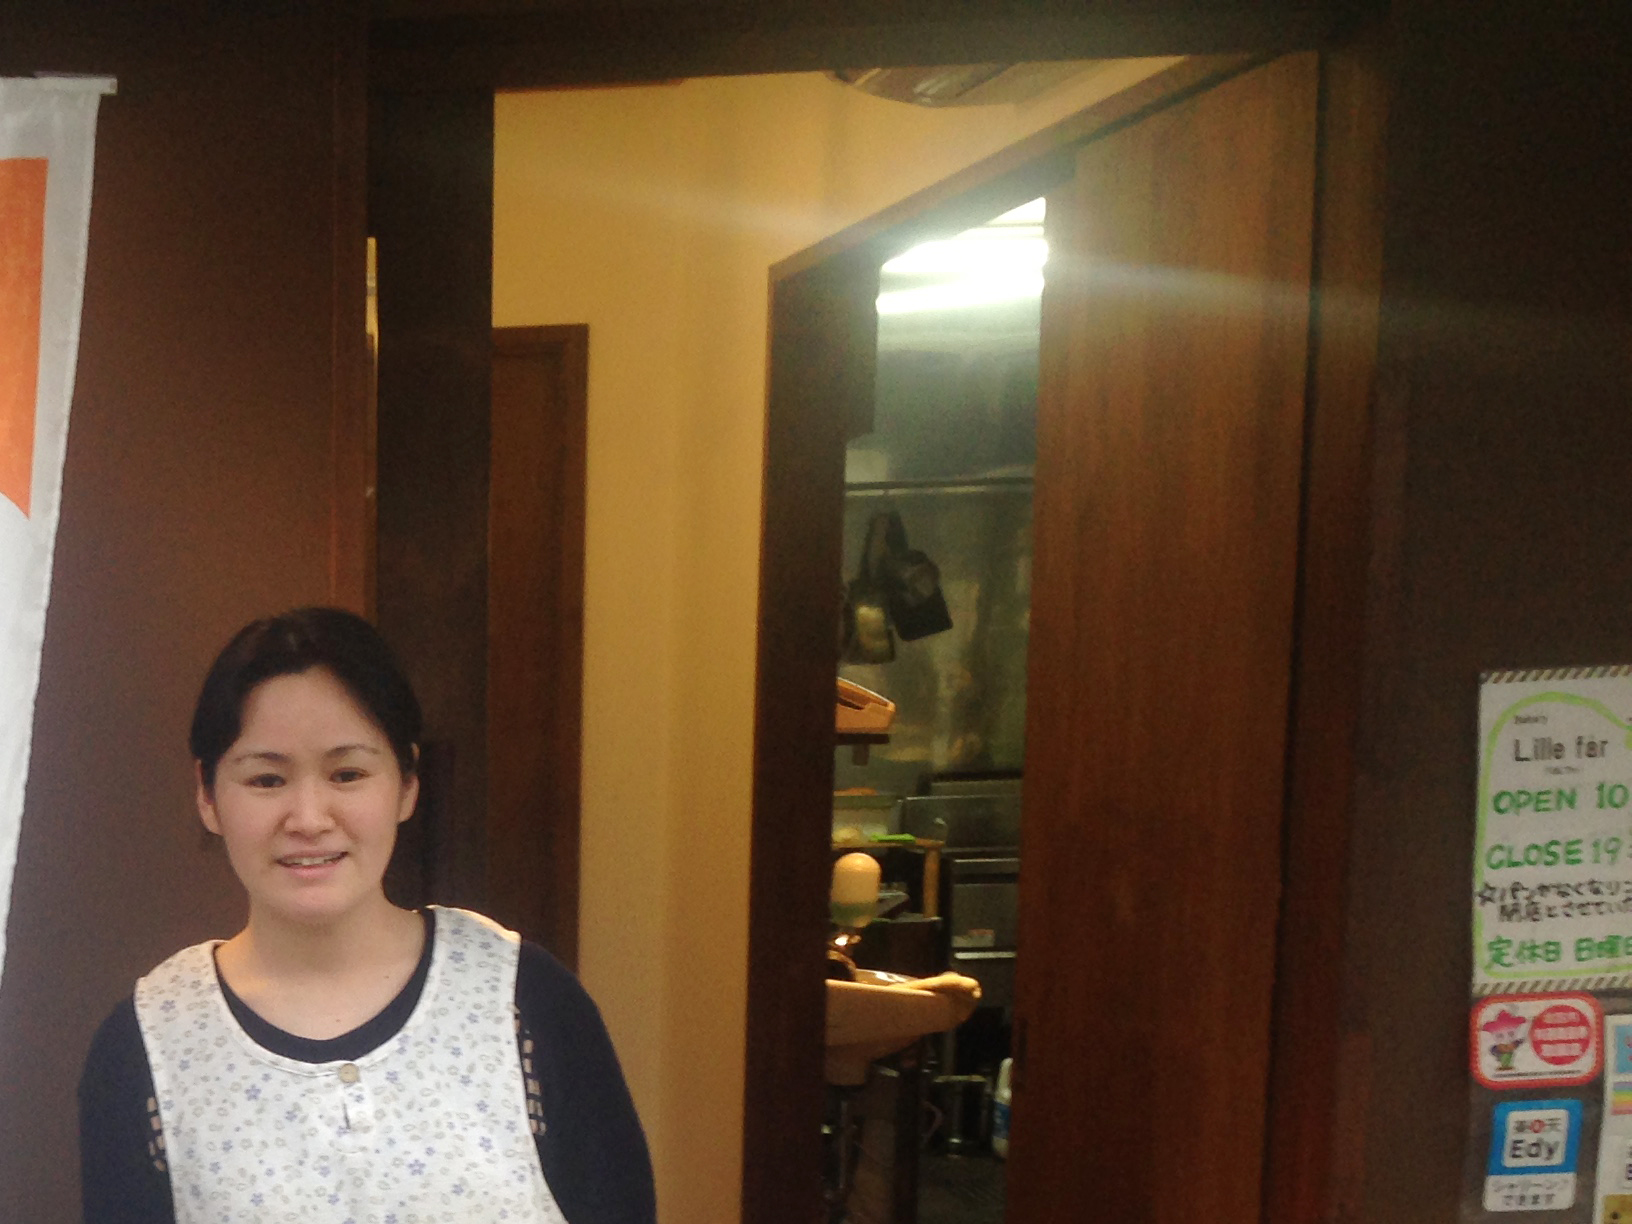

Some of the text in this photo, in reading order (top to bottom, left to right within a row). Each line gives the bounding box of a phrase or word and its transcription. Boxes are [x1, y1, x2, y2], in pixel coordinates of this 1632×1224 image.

[1493, 788, 1577, 815] OPEN
[1487, 839, 1583, 870] CLOSE
[1510, 1137, 1561, 1162] Edy
